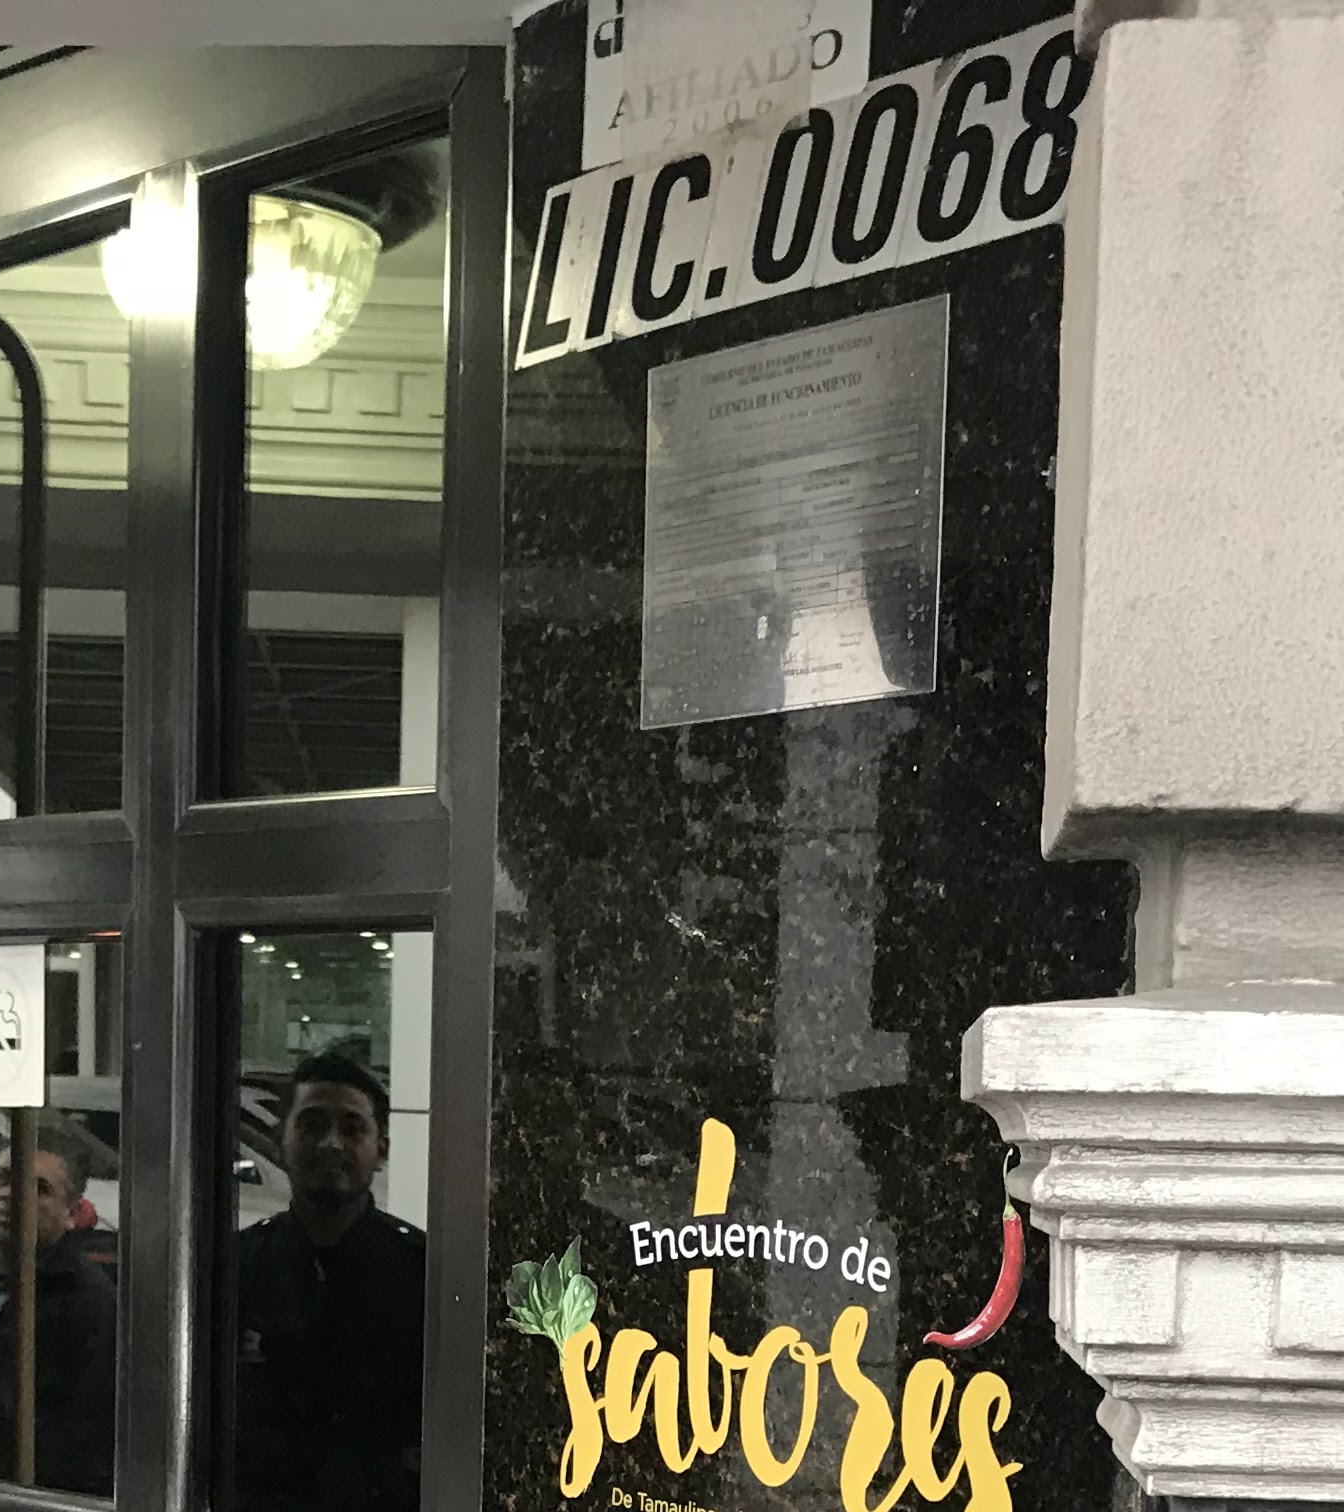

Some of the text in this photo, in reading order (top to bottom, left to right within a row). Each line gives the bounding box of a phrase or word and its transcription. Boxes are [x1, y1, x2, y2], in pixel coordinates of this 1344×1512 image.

[630, 1218, 892, 1293] Encuentro de
[611, 1486, 633, 1509] De
